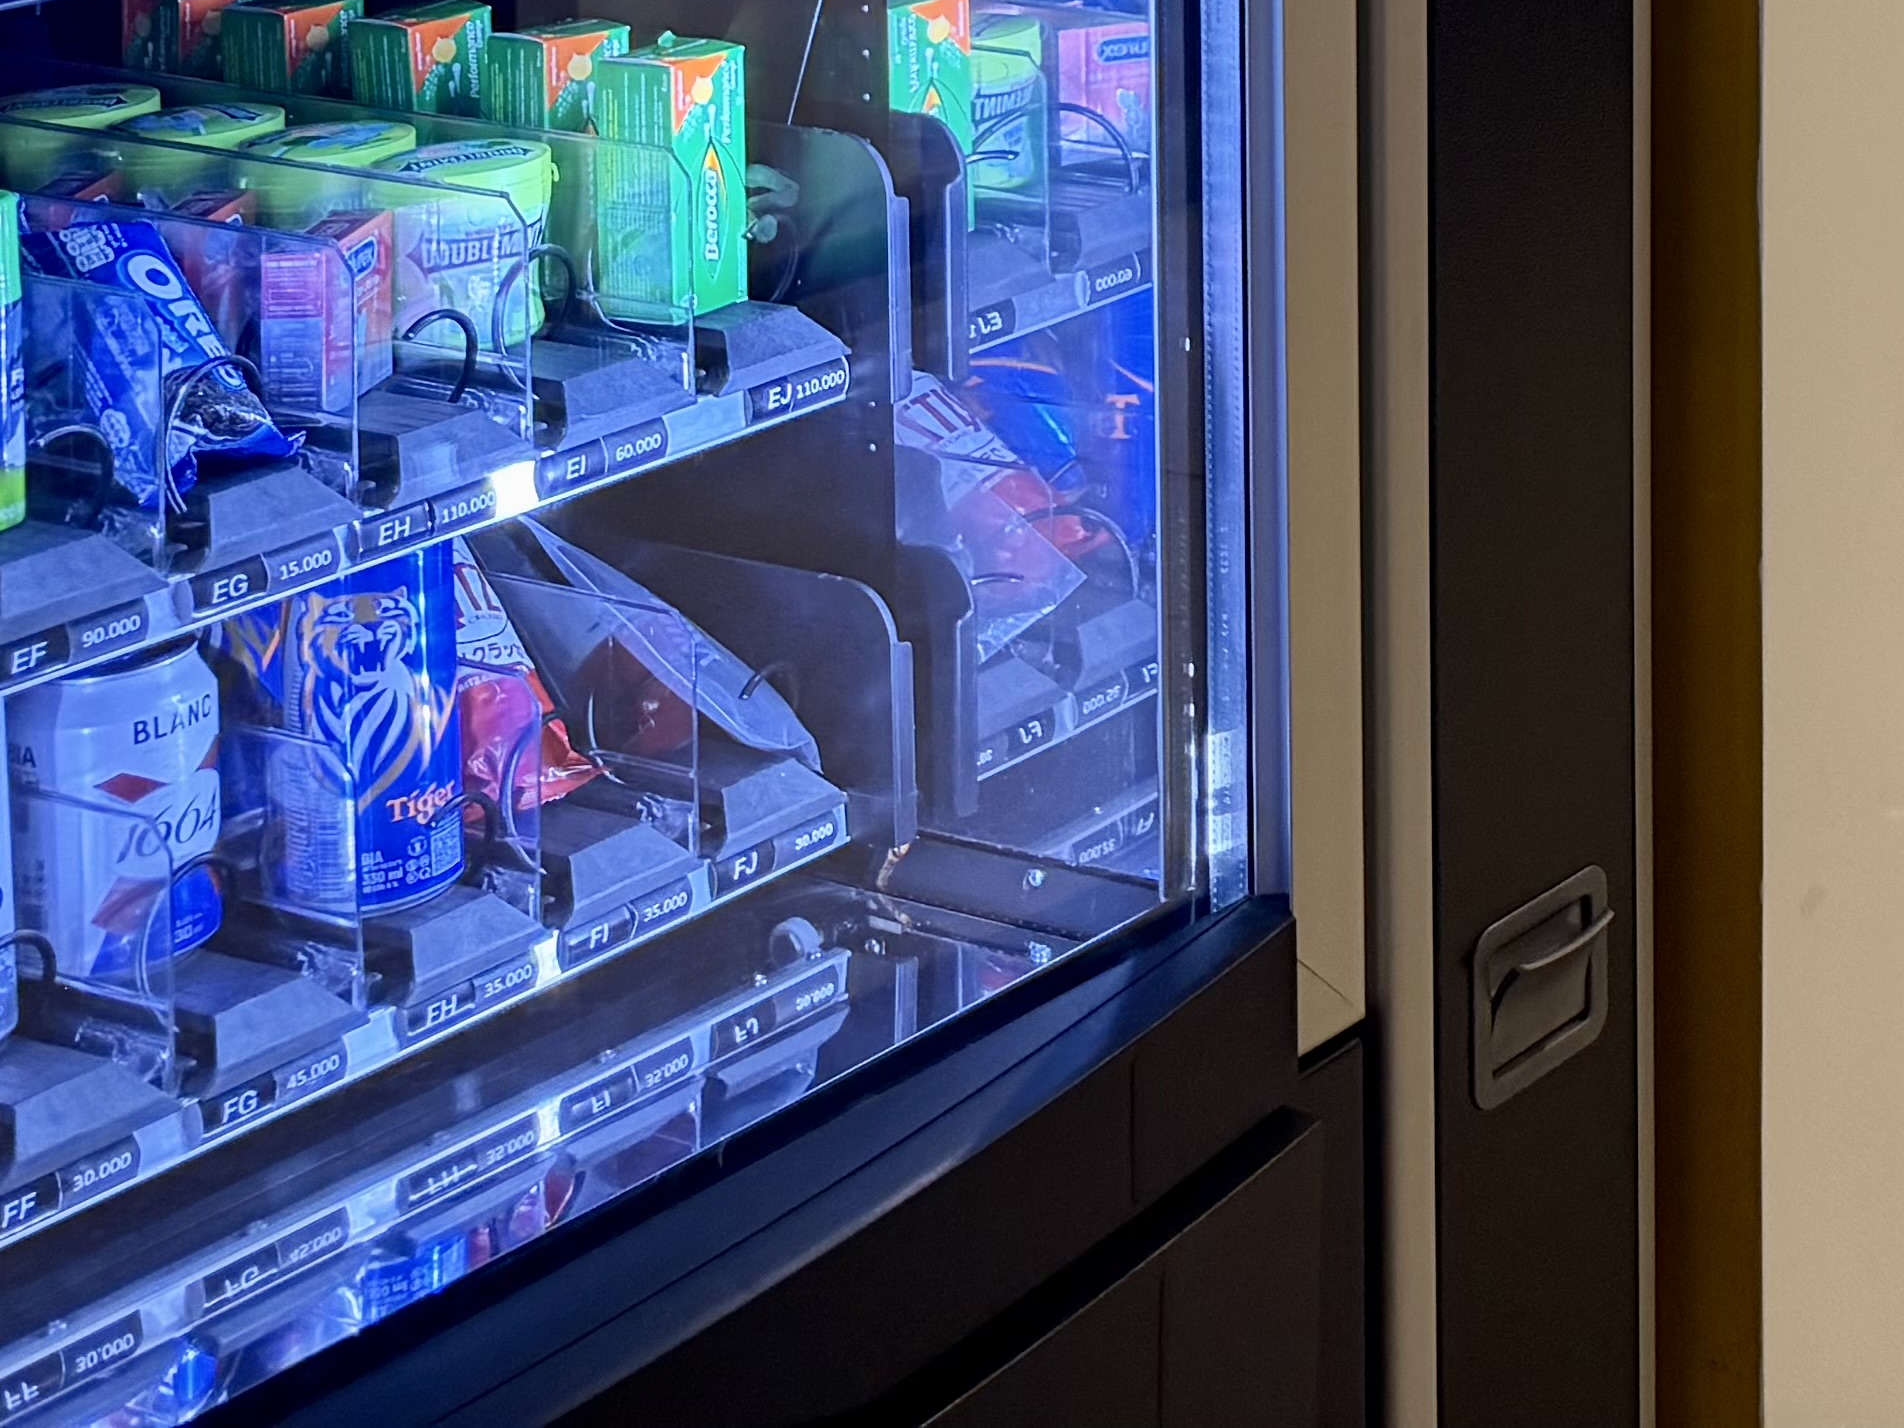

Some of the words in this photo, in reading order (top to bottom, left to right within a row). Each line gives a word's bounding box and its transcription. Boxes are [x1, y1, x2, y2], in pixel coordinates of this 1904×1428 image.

[704, 169, 719, 261] Berocca
[768, 383, 792, 410] EJ
[796, 370, 845, 400] 110.000
[566, 455, 585, 479] EI
[615, 434, 662, 462] 60.000
[378, 518, 411, 546] EH
[442, 491, 496, 523] 110.000
[213, 573, 248, 604] EG
[280, 551, 332, 580] 15.000
[11, 642, 47, 674] EF
[82, 615, 141, 648] 90.000
[133, 694, 212, 744] BLANC
[116, 790, 218, 864] 1664
[386, 780, 455, 825] Tiger
[362, 871, 385, 885] 330
[733, 852, 758, 880] FJ
[589, 924, 610, 949] FI
[643, 893, 688, 922] 35.000
[426, 996, 458, 1026] FH
[483, 964, 532, 997] 35.000
[221, 1091, 258, 1124] FG
[286, 1055, 340, 1090] 45.000
[2, 1192, 37, 1228] FF
[73, 1152, 133, 1192] 30.000
